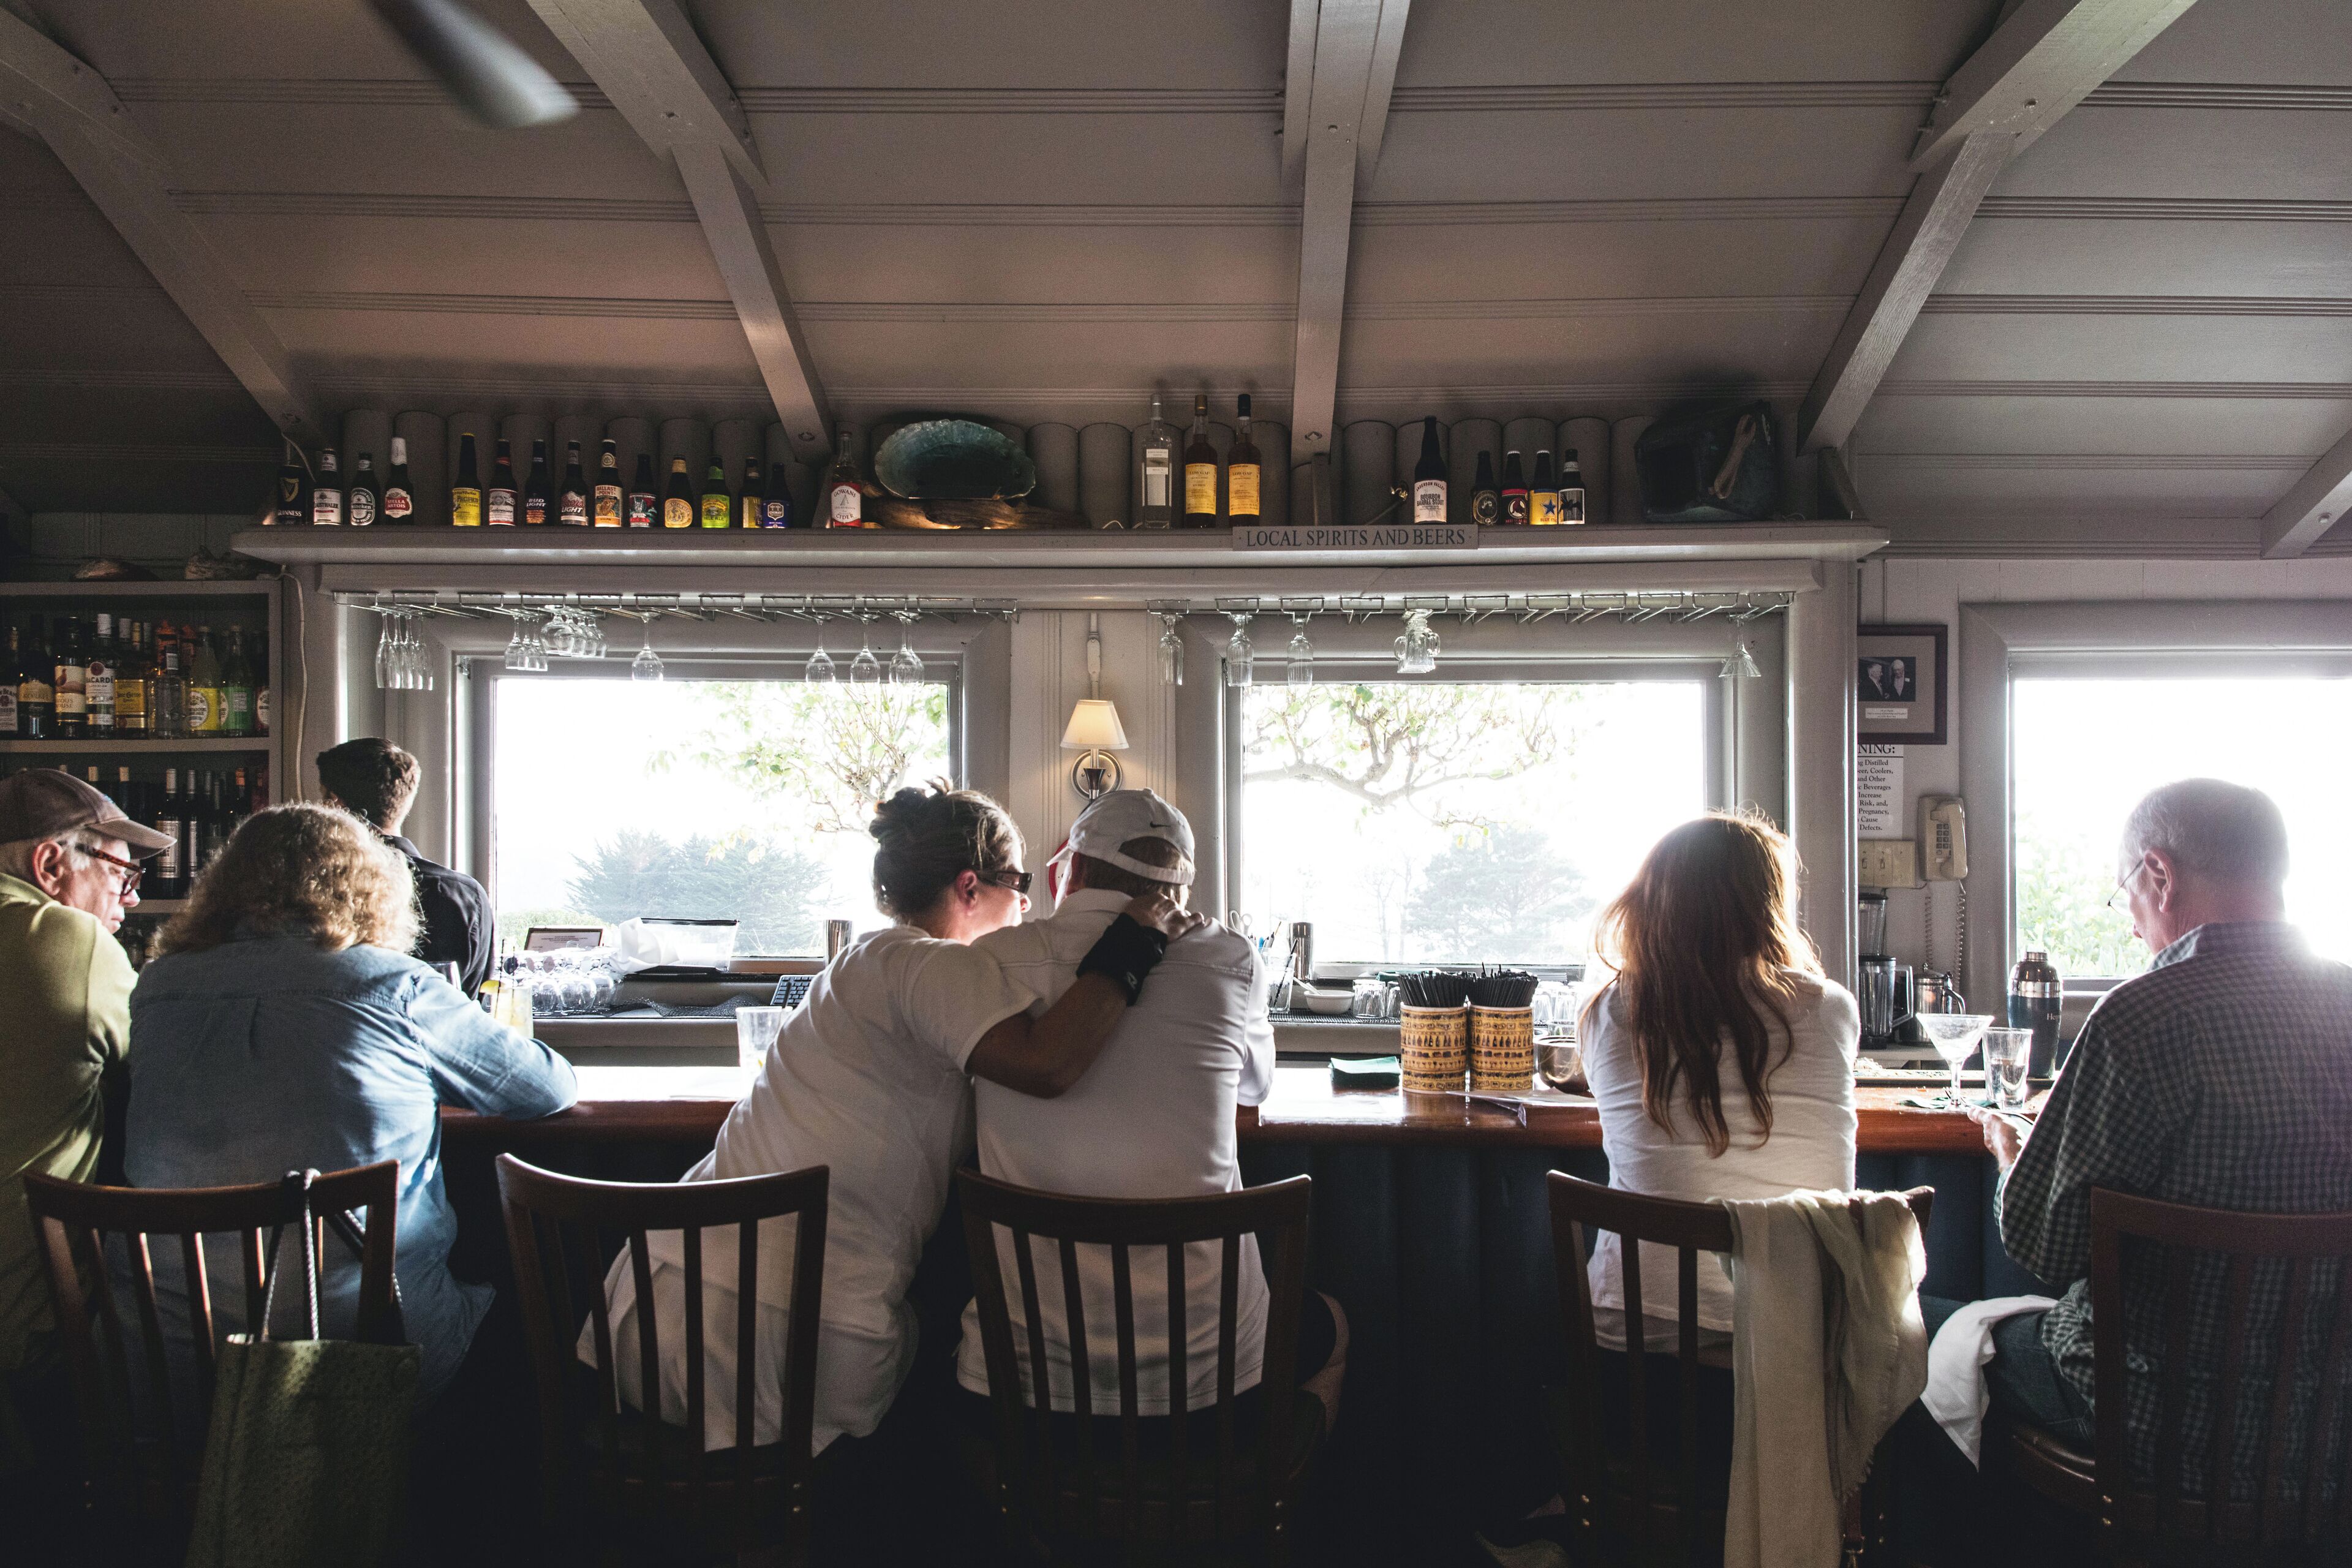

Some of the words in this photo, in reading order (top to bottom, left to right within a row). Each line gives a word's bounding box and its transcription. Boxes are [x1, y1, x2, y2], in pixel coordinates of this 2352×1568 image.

[834, 488, 857, 498] GOWANS
[277, 509, 303, 518] GUINNESS
[1246, 529, 1302, 546] LOCAL
[1306, 529, 1368, 546] SPIRITS
[1372, 529, 1409, 545] AND
[1412, 528, 1465, 545] BEERS
[1858, 744, 1895, 754] NING:
